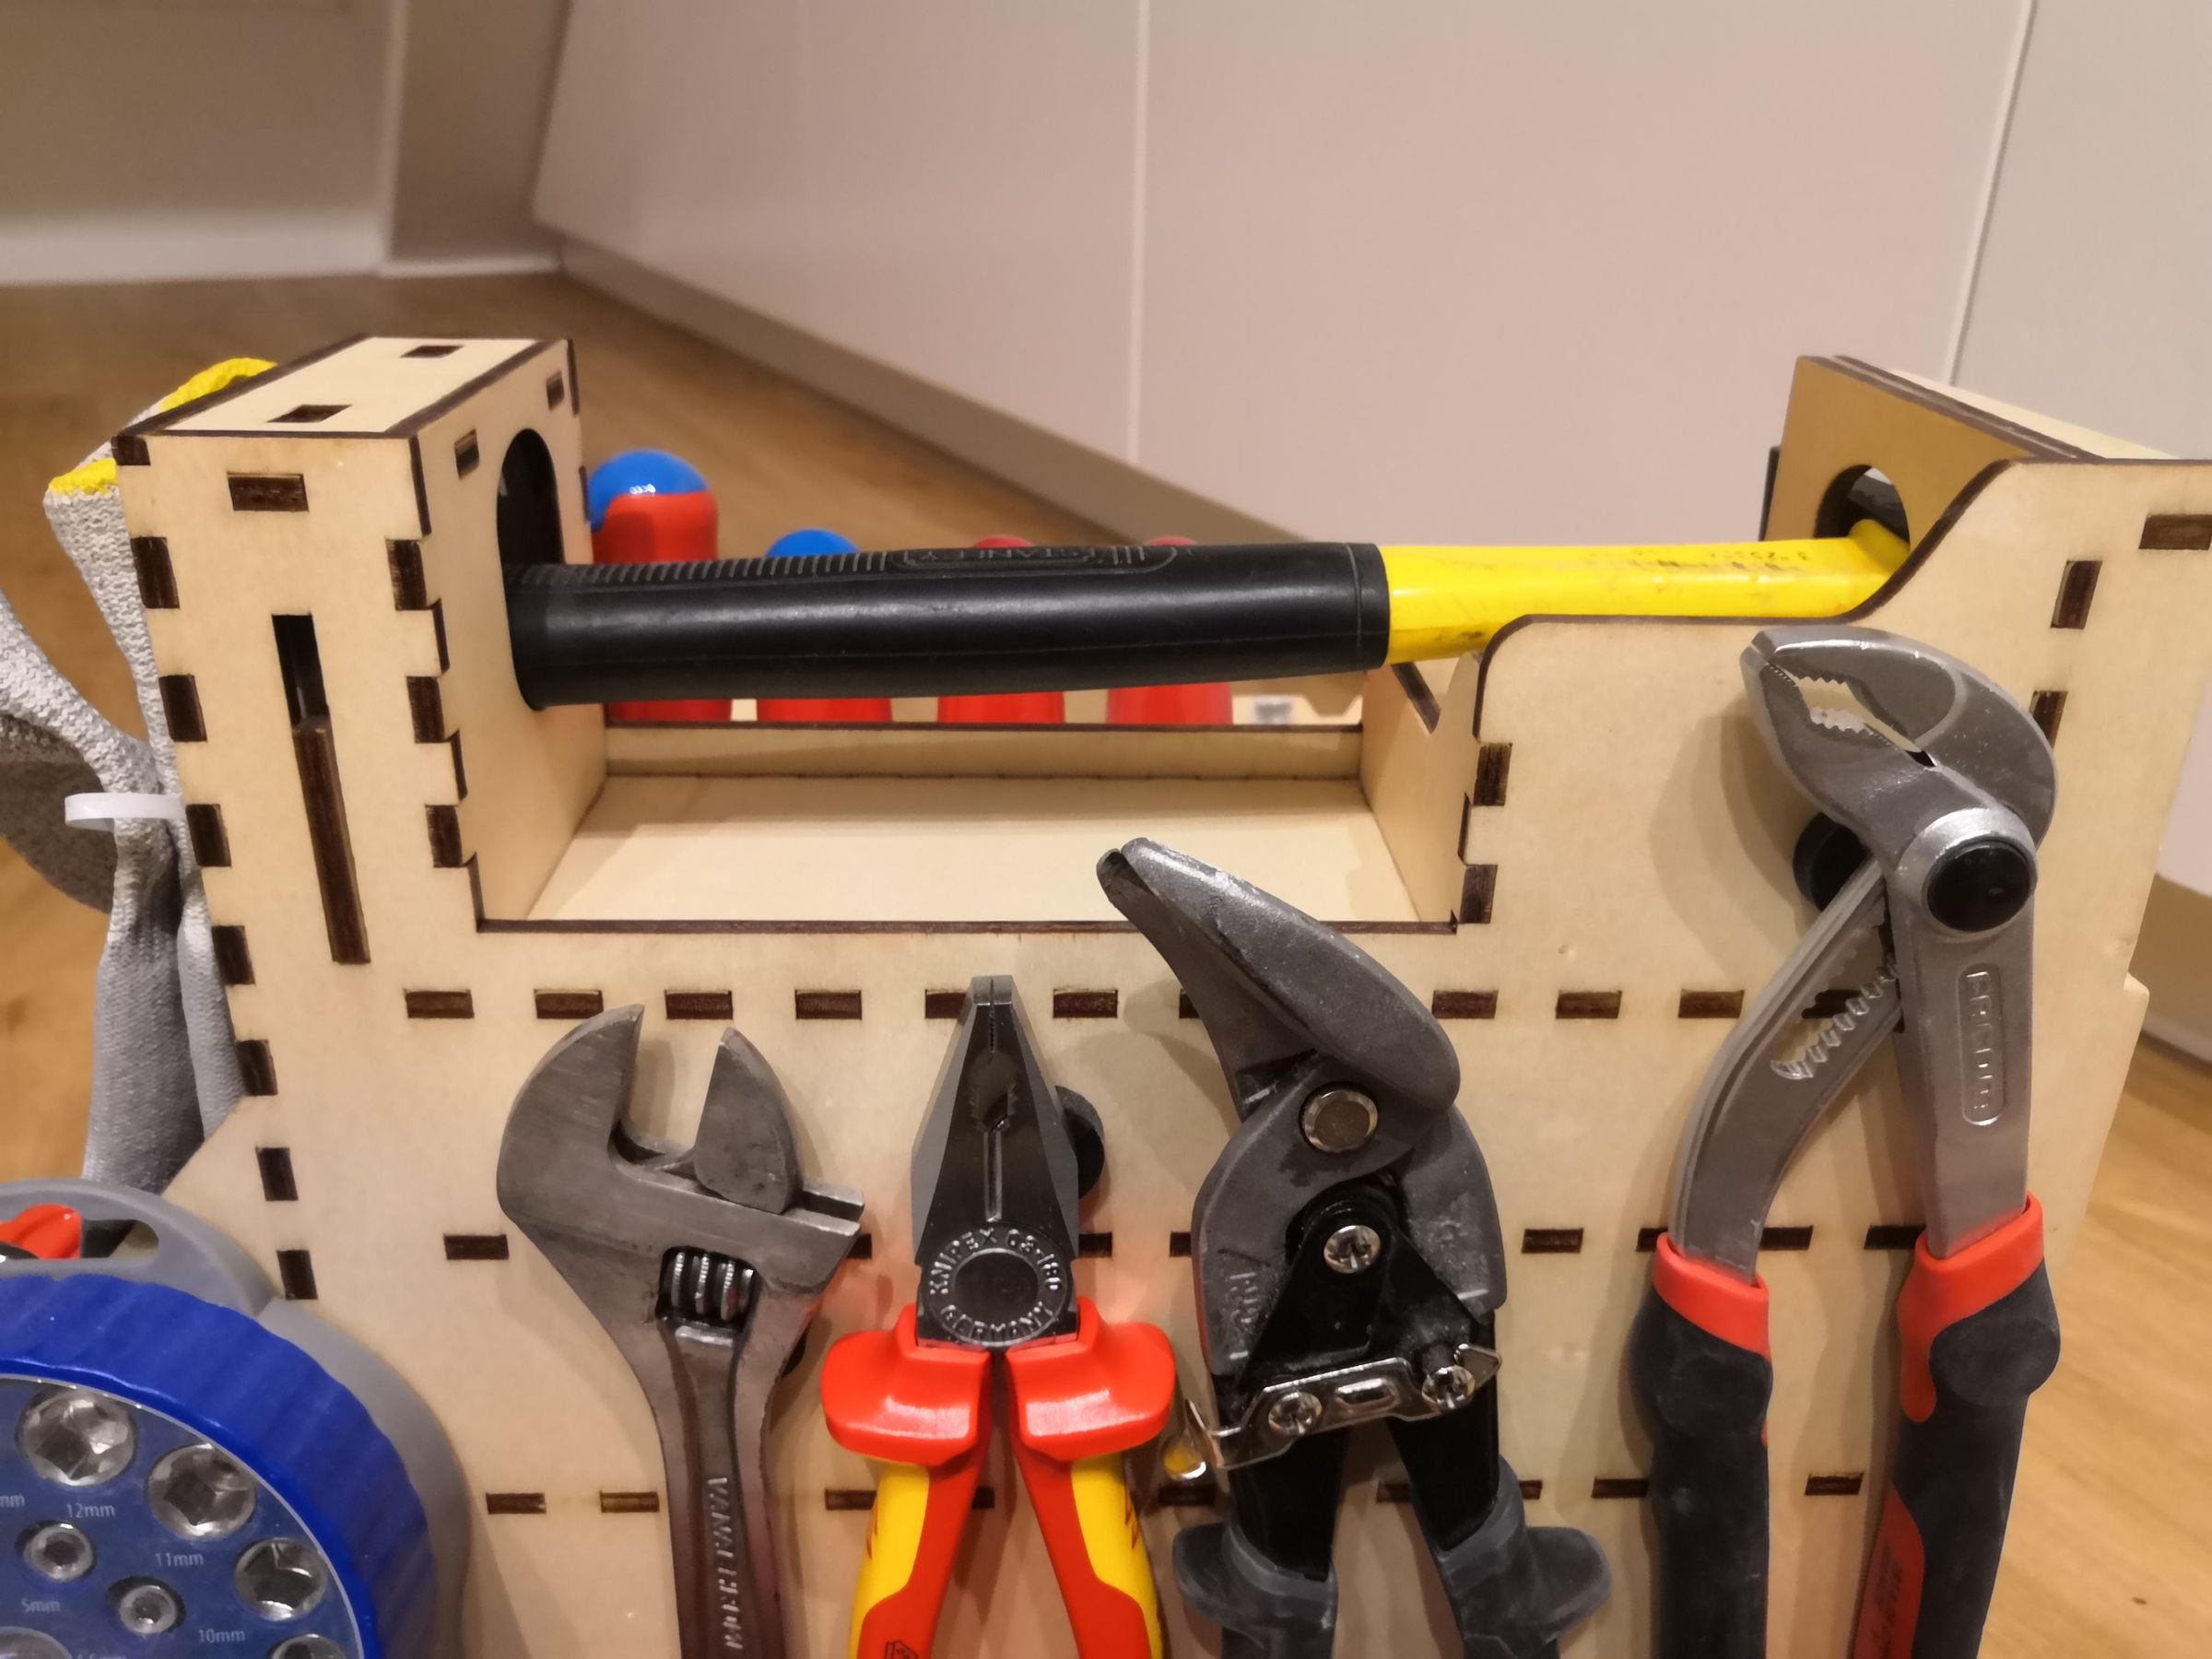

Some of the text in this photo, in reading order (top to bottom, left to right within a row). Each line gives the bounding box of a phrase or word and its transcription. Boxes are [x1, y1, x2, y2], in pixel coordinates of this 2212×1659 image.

[928, 1227, 998, 1295] KNIPEX
[939, 1300, 1054, 1340] GERMANY
[65, 1503, 116, 1519] 12mm
[154, 1552, 205, 1567] 11mm
[21, 1597, 61, 1614] 5mm
[198, 1628, 246, 1643] 10mm
